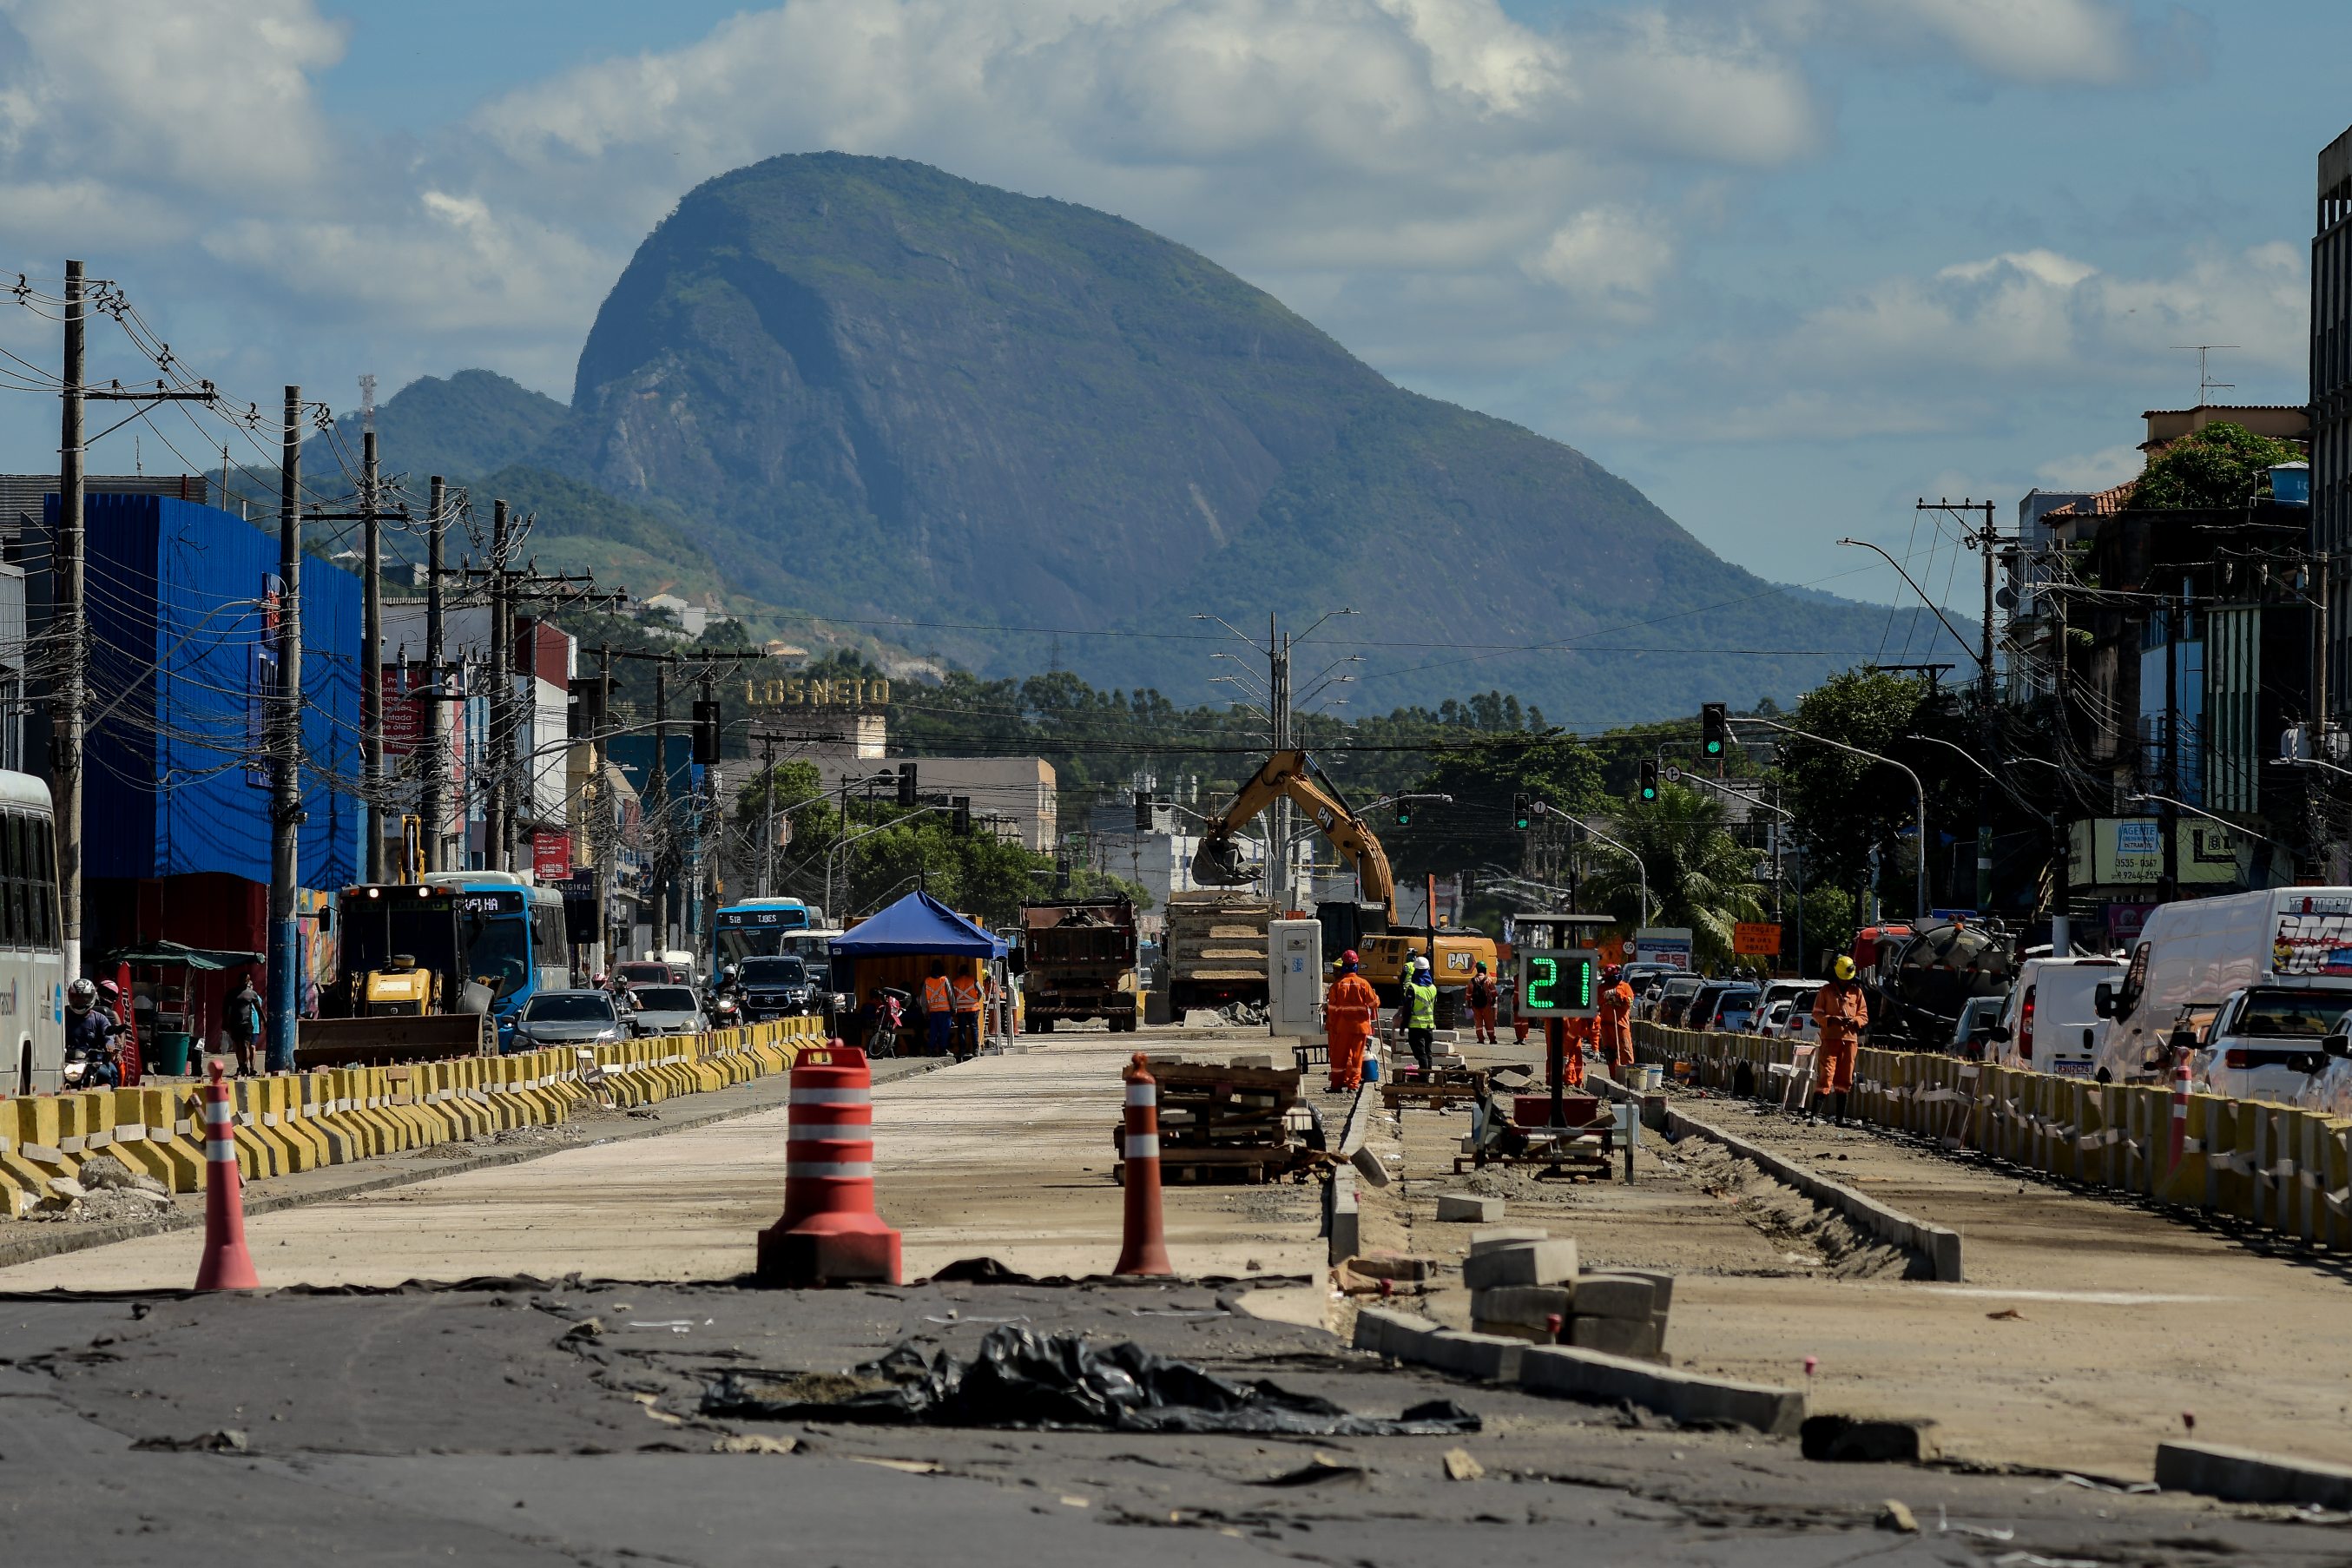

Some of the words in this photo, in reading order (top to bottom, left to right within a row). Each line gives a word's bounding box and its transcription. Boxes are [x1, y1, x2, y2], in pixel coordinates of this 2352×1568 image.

[1317, 806, 1334, 828] CAT
[1447, 952, 1471, 970] CAT
[1528, 958, 1590, 1008] 21
